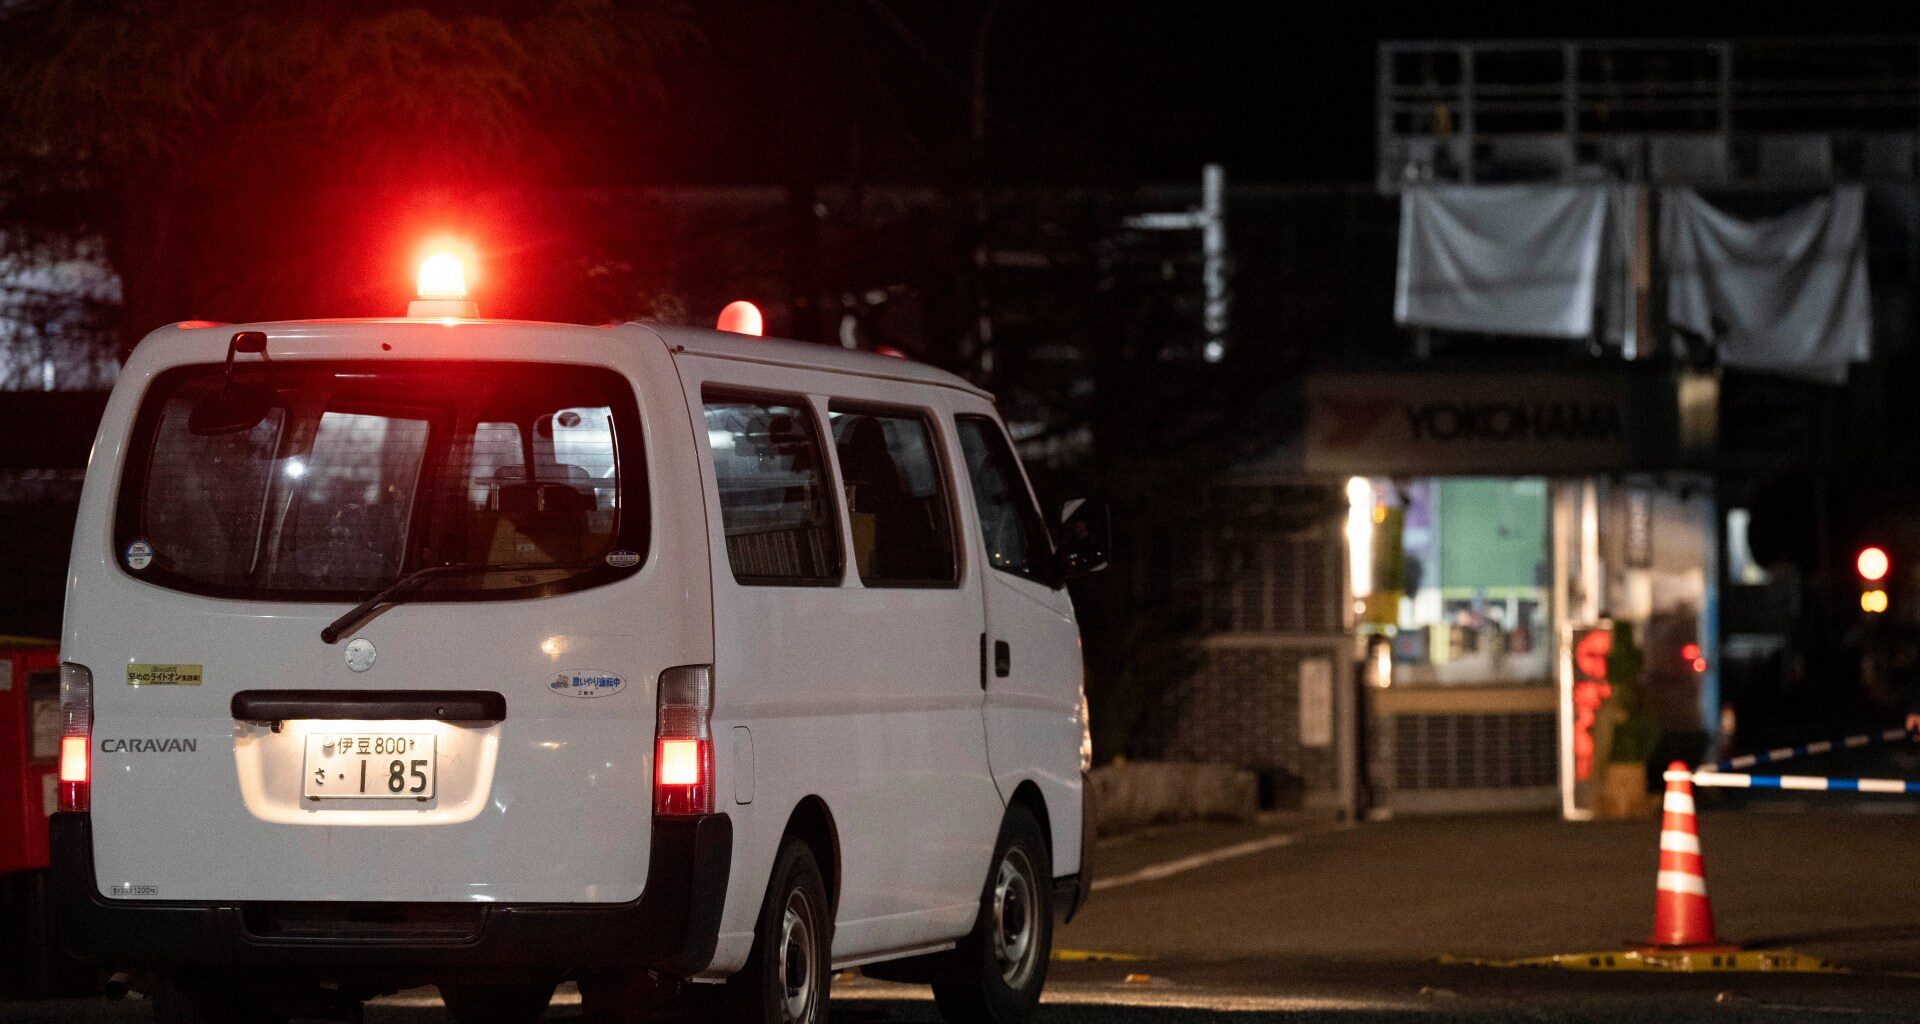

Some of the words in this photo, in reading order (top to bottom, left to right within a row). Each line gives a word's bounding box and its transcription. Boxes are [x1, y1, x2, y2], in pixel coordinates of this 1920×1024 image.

[572, 676, 621, 687] 思いやり運転中
[100, 738, 197, 753] CARAVAN
